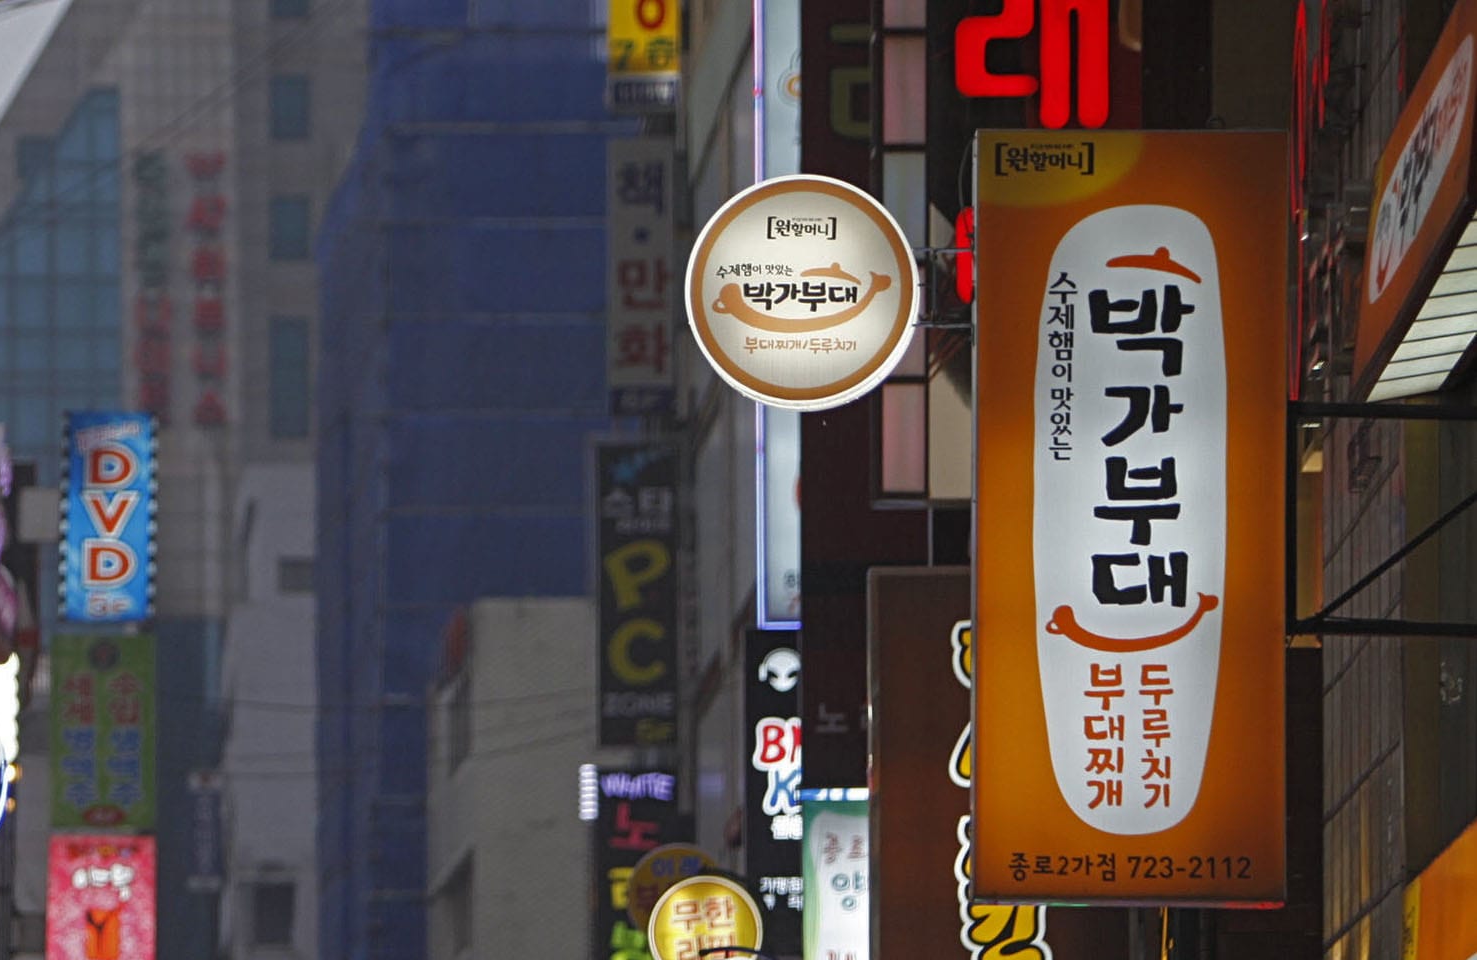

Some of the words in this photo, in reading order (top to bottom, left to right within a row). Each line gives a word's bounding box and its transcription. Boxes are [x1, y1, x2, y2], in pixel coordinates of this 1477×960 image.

[715, 262, 763, 280] 수제햄이
[765, 263, 794, 278] 맛있는
[742, 280, 859, 312] 박가부대
[1046, 271, 1079, 384] 수제햄이
[1048, 386, 1076, 461] 맛있는
[1087, 284, 1196, 608] 박가부대
[82, 442, 138, 590] DVD
[1083, 663, 1126, 810] 부대찌개
[1138, 663, 1175, 809] 두루치기
[1008, 853, 1117, 882] 종로2가점
[1127, 855, 1252, 880] 723-2112
